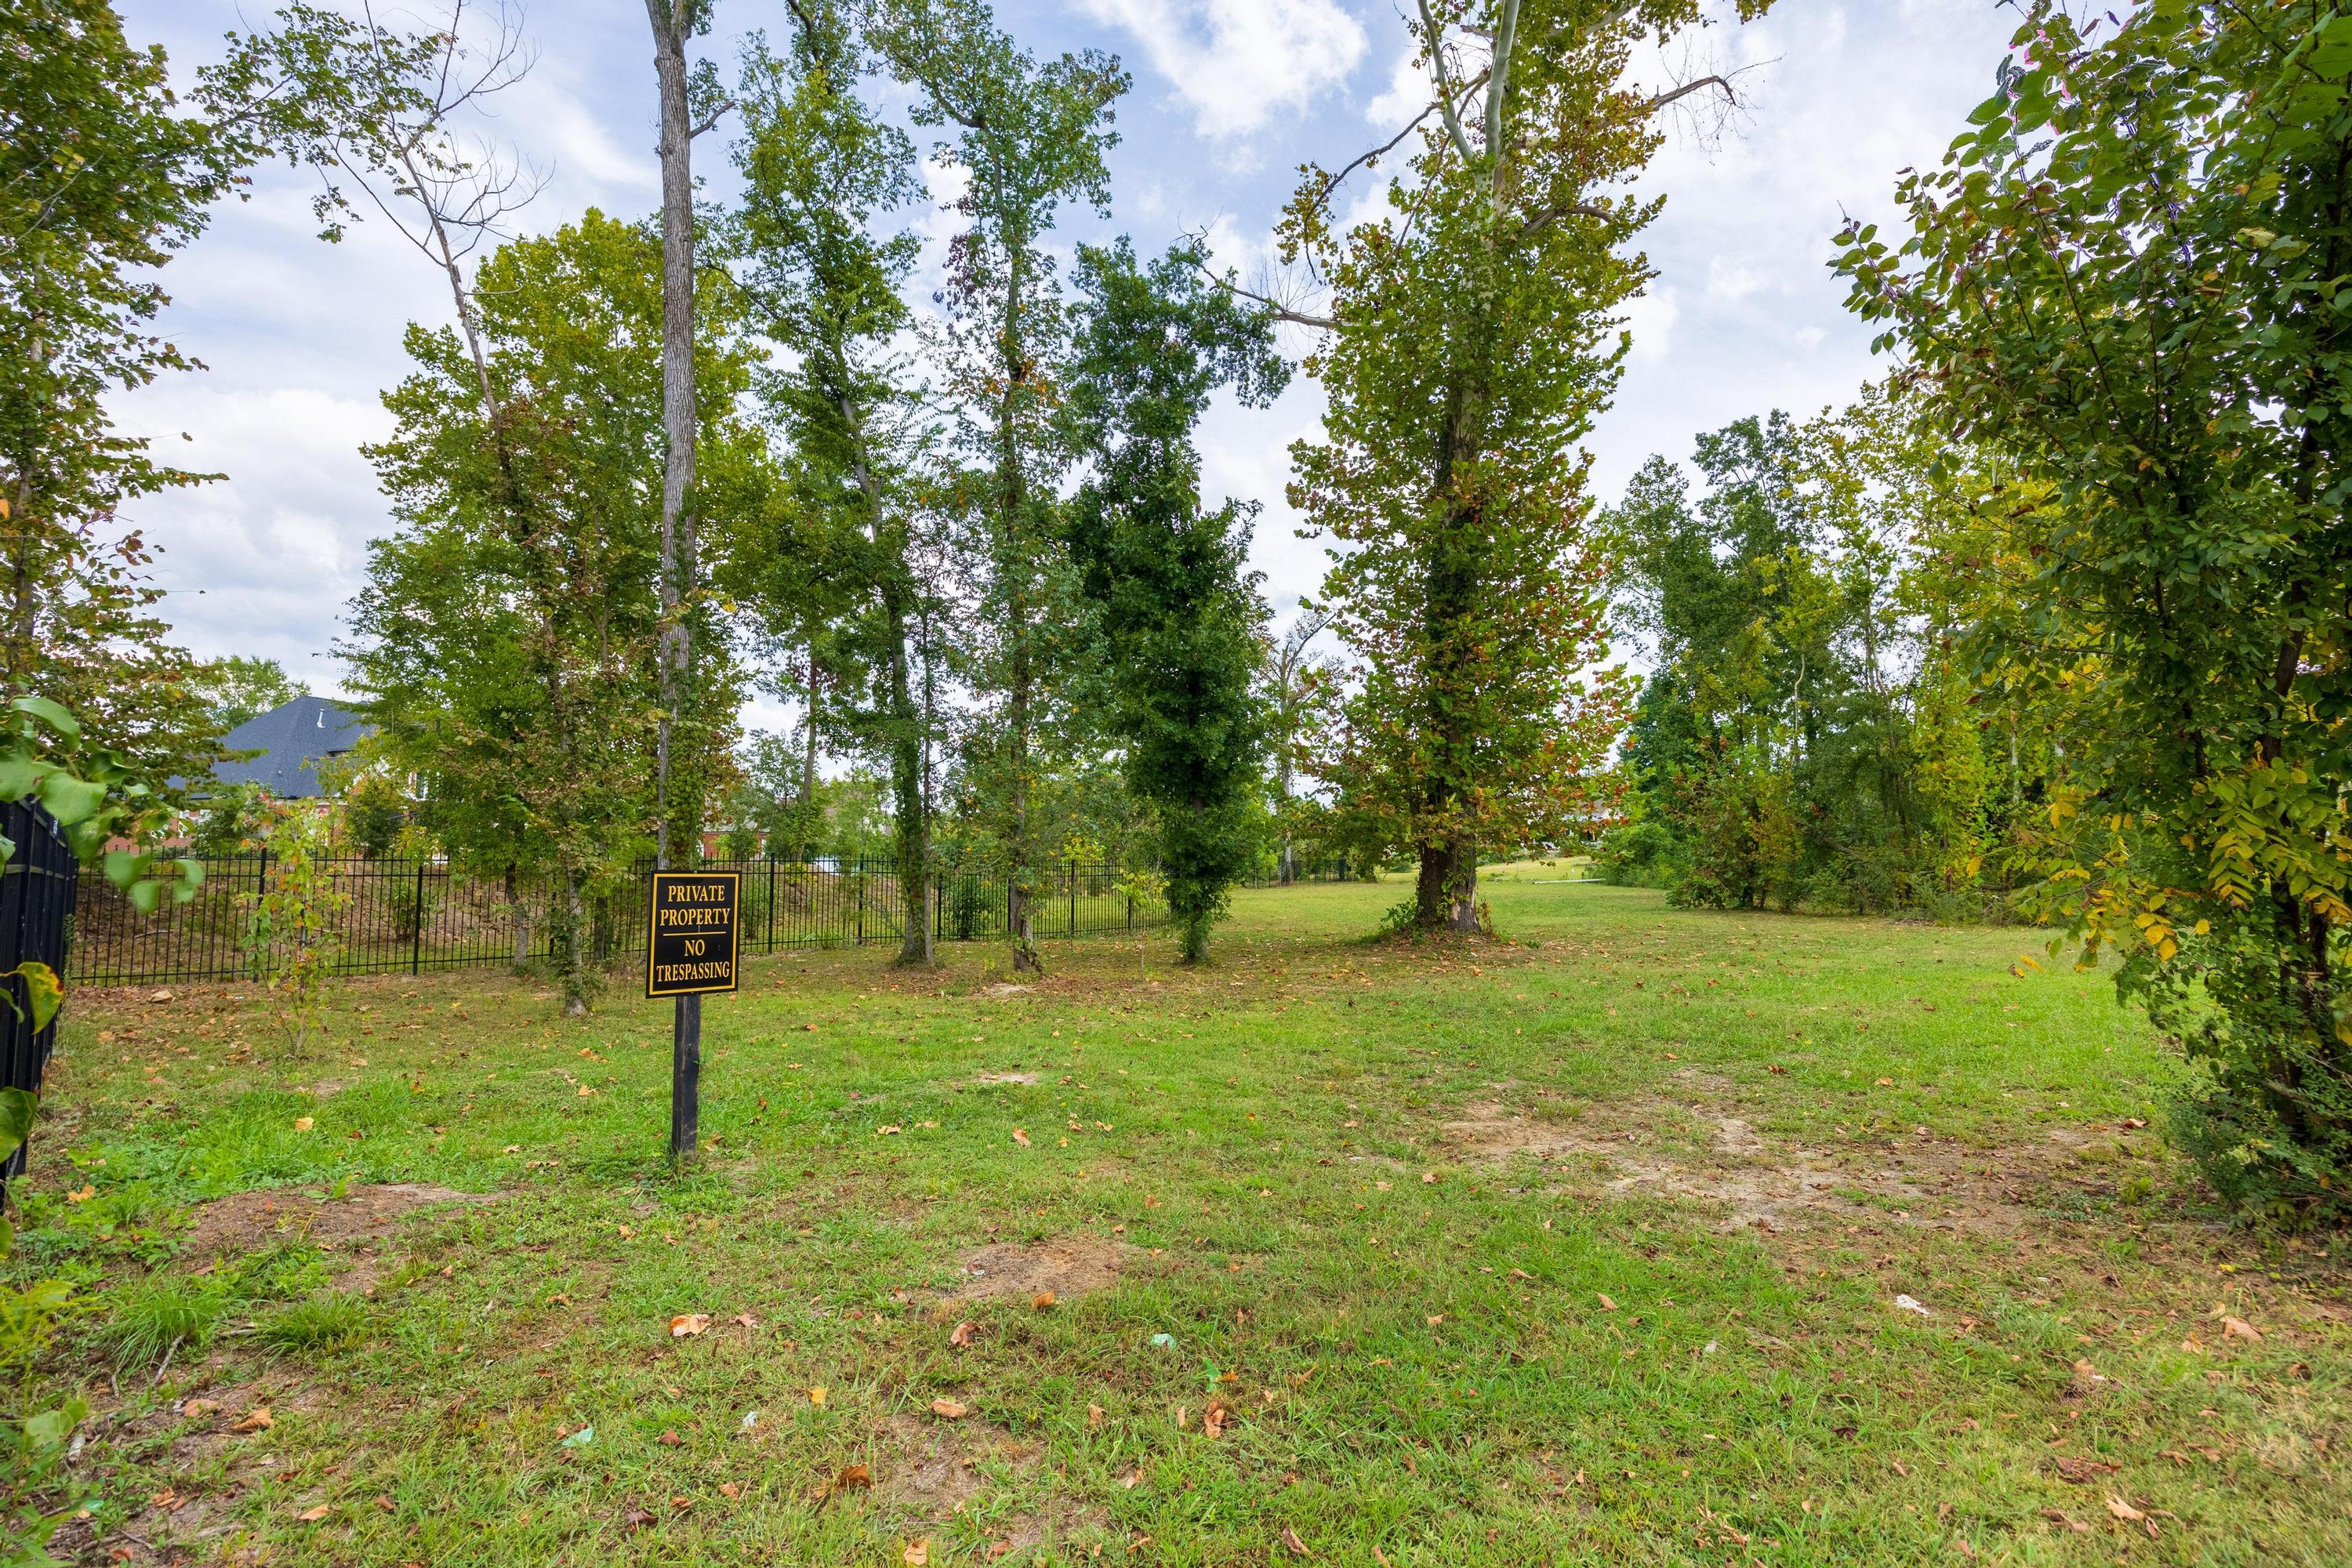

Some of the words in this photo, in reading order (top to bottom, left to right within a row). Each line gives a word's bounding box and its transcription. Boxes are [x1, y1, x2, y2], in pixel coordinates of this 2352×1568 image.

[667, 885, 725, 902] PRIVATE
[659, 908, 731, 926] PROPERTY
[684, 939, 706, 956] NO
[656, 961, 730, 982] TRESPASSING
